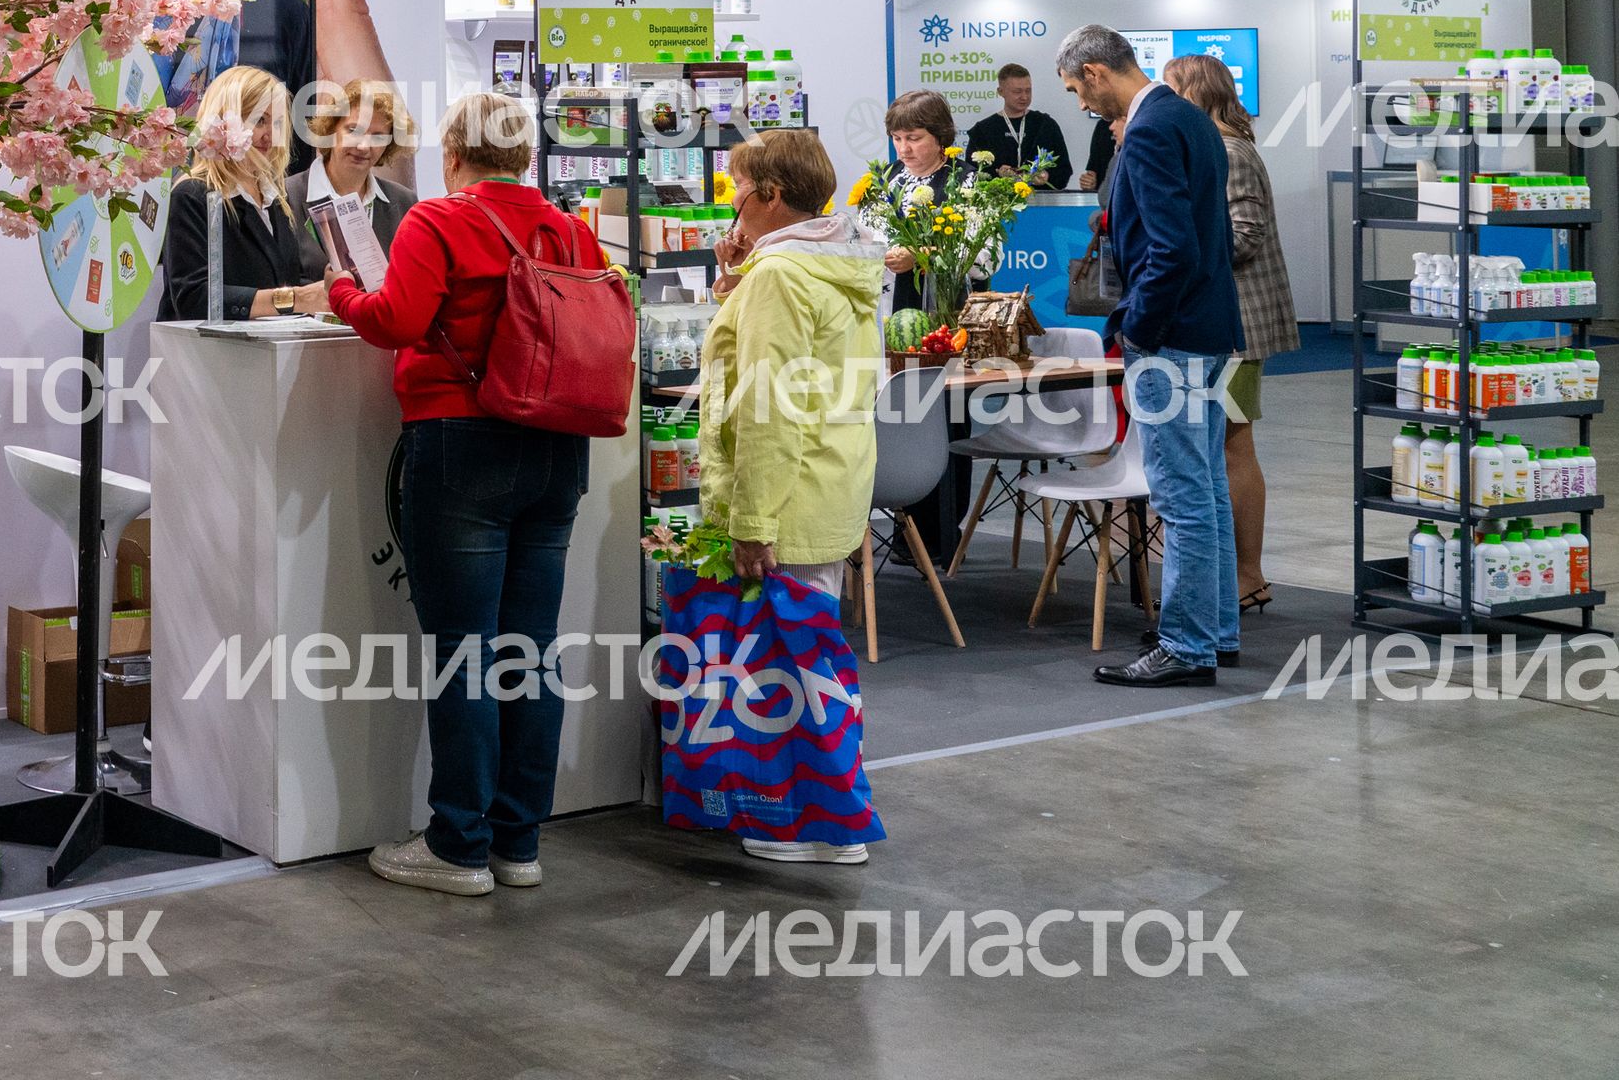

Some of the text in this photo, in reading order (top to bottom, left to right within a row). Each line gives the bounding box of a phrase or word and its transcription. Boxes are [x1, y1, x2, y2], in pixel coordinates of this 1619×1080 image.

[649, 24, 708, 35] Выращивайте
[962, 20, 1047, 39] INSPIRO
[649, 37, 708, 48] органическое!
[920, 51, 994, 68] ДО +30%
[759, 794, 783, 804] Ozon!
